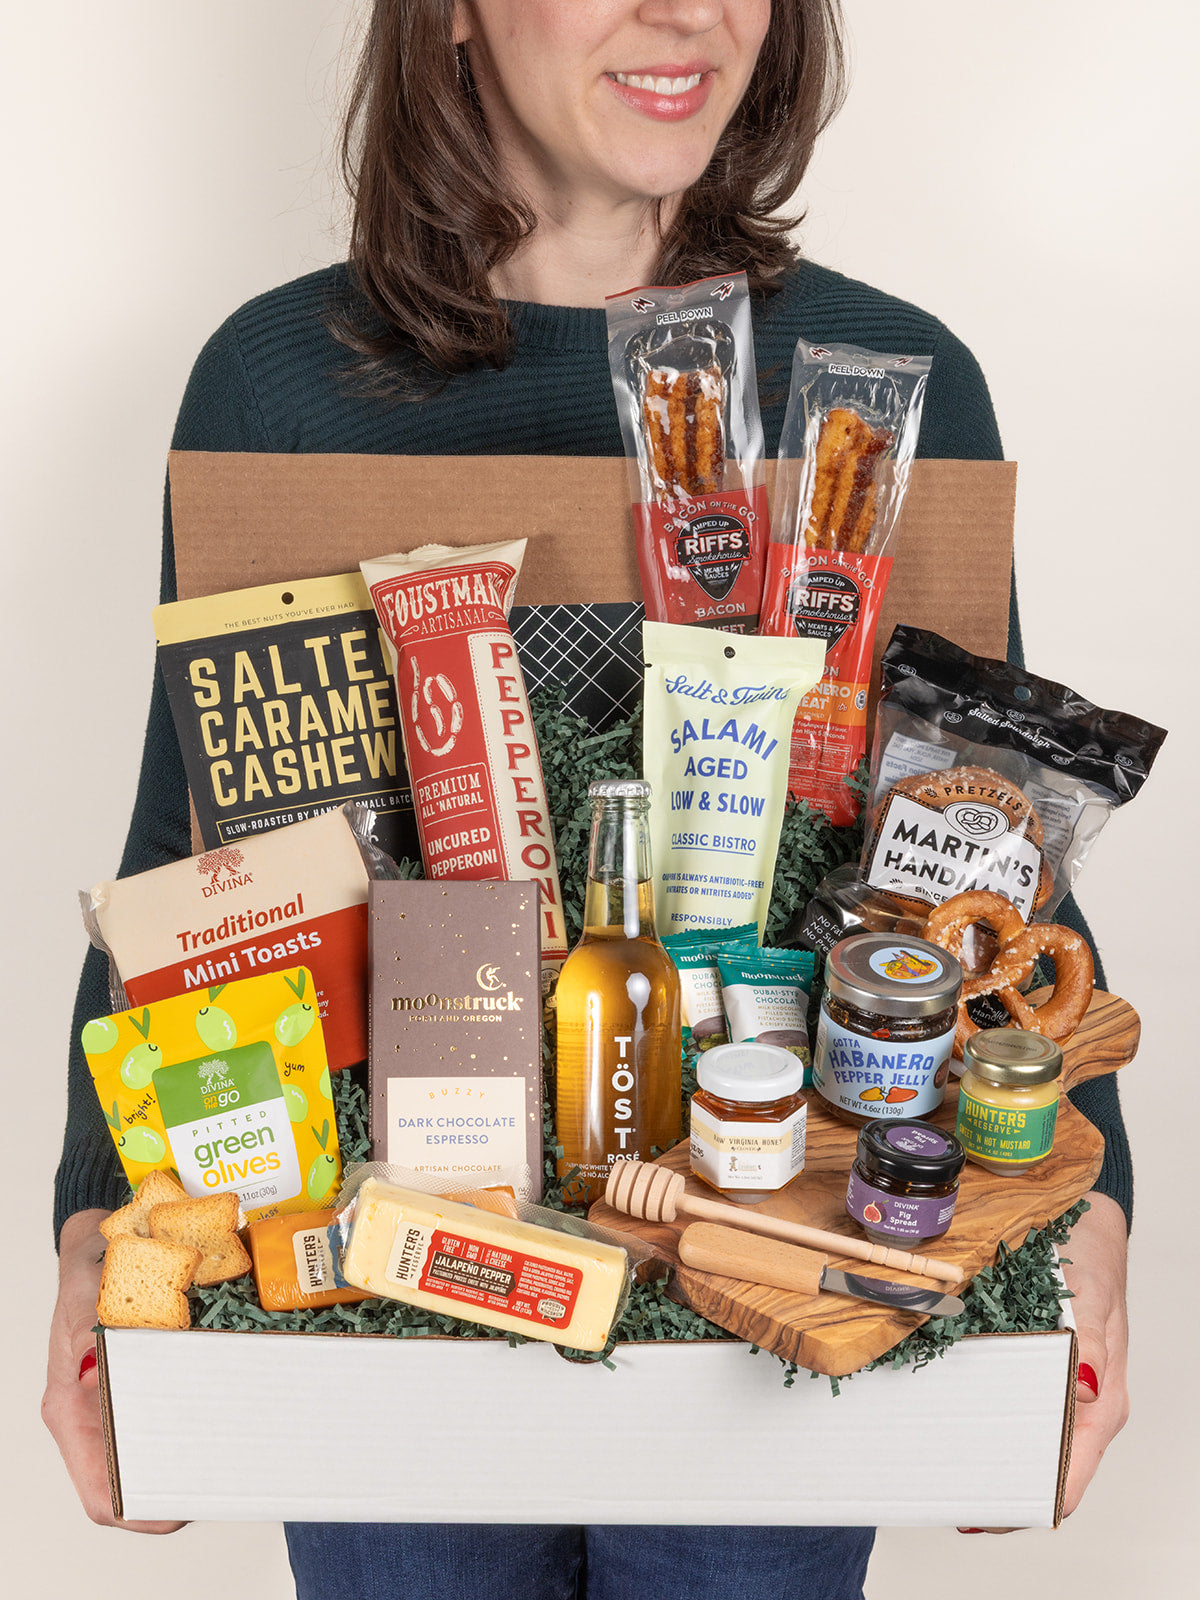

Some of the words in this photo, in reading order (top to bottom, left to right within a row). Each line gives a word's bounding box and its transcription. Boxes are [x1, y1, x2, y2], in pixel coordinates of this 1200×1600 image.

[656, 310, 678, 325] PEEL
[680, 307, 713, 322] DOWN
[829, 364, 851, 375] PEEL
[853, 365, 885, 378] DOWN
[723, 501, 737, 511] THE
[738, 506, 757, 522] GO
[692, 520, 718, 532] AMPED
[685, 531, 744, 556] RIFFS
[808, 576, 834, 584] AMPED
[835, 578, 845, 587] UP
[857, 571, 874, 589] GO
[793, 589, 855, 612] RIFFS
[242, 619, 261, 627] BEST
[263, 615, 283, 624] NUTS
[285, 609, 314, 620] YOU'VE
[316, 605, 336, 615] EVER
[337, 602, 355, 612] HAD
[697, 603, 746, 618] BACON
[420, 607, 489, 635] ARTISANAL
[665, 675, 713, 700] Salt
[711, 688, 728, 706] &
[811, 683, 851, 698] NERO
[200, 680, 395, 758] CARAME
[967, 707, 1001, 728] Salted
[1000, 717, 1051, 748] Sourdough
[670, 718, 778, 761] SALAMI
[209, 730, 397, 808] CASHEW
[684, 756, 748, 780] AGED
[418, 772, 481, 804] PREMIUM
[487, 642, 559, 939] PEPPERONI
[671, 790, 694, 811] LOW
[698, 790, 711, 811] &
[717, 792, 766, 817] SLOW
[944, 785, 1023, 812] PRETZELS
[225, 812, 294, 836] SLOW-ROASTED
[297, 810, 311, 821] BY
[355, 798, 386, 808] SMALL
[389, 794, 413, 806] BATC
[422, 804, 436, 819] ALL
[427, 827, 491, 856] UNCURED
[671, 832, 709, 847] CLASSIC
[712, 835, 757, 852] BISTRO
[892, 819, 1034, 888] MARTIN'S
[431, 848, 498, 879] PEPPERONI
[202, 874, 252, 898] DIVINA
[682, 873, 708, 883] ALWAYS
[689, 886, 699, 895] OR
[701, 888, 732, 898] NITRITES
[914, 886, 949, 902] SINCE
[176, 893, 305, 953] Traditional
[671, 913, 733, 927] RESPONSIBLY
[810, 921, 823, 934] No
[817, 915, 830, 928] No
[830, 924, 844, 937] Fat
[802, 927, 816, 940] No
[183, 952, 240, 989] Mini
[241, 930, 322, 969] Toasts
[680, 952, 719, 963] moons
[741, 971, 805, 982] moonstruck
[391, 991, 522, 1011] moonstruck
[753, 989, 799, 997] DUBAI-STY
[755, 997, 799, 1005] CHOCOLAT
[409, 1015, 460, 1023] PORTLAND
[463, 1014, 502, 1022] OREGON
[833, 1038, 861, 1048] GOTTA
[283, 1060, 305, 1077] yum
[828, 1050, 935, 1071] HABANERO
[200, 1078, 234, 1095] DIVINA
[834, 1071, 884, 1085] PEPPER
[890, 1073, 930, 1085] JELLY
[203, 1095, 217, 1105] on
[218, 1090, 240, 1107] go
[428, 1087, 485, 1100] BUZZY
[611, 1036, 635, 1149] TÖST
[124, 1093, 157, 1125] bright!
[204, 1102, 218, 1110] THE
[840, 1095, 850, 1106] NET
[851, 1100, 862, 1109] WT
[863, 1104, 881, 1114] 4.6oz
[882, 1106, 904, 1115] (130g)
[965, 1099, 1026, 1128] HUNTER'S
[192, 1110, 267, 1138] PITTED
[398, 1117, 434, 1128] DARK
[436, 1117, 516, 1128] CHOCOLATE
[973, 1119, 1011, 1135] RESERVE
[194, 1126, 275, 1168] green
[426, 1134, 489, 1145] ESPRESSO
[729, 1138, 759, 1146] VIRGINIA
[984, 1136, 997, 1148] HOT
[1000, 1139, 1031, 1150] MUSTARD
[607, 1151, 640, 1164] ROSÉ
[203, 1151, 281, 1188] olives
[894, 1201, 919, 1211] DIVINA
[889, 1216, 917, 1227] Spread
[899, 1211, 912, 1220] Fig
[441, 1236, 461, 1248] GLUTEN
[442, 1244, 455, 1254] FREE
[303, 1234, 323, 1288] HUNTER'S
[396, 1228, 421, 1281] HUNTER'S
[489, 1257, 507, 1268] CHEESE
[491, 1250, 513, 1263] NATURAL
[435, 1255, 479, 1275] JALAPEÑO
[480, 1267, 511, 1284] PEPPER
